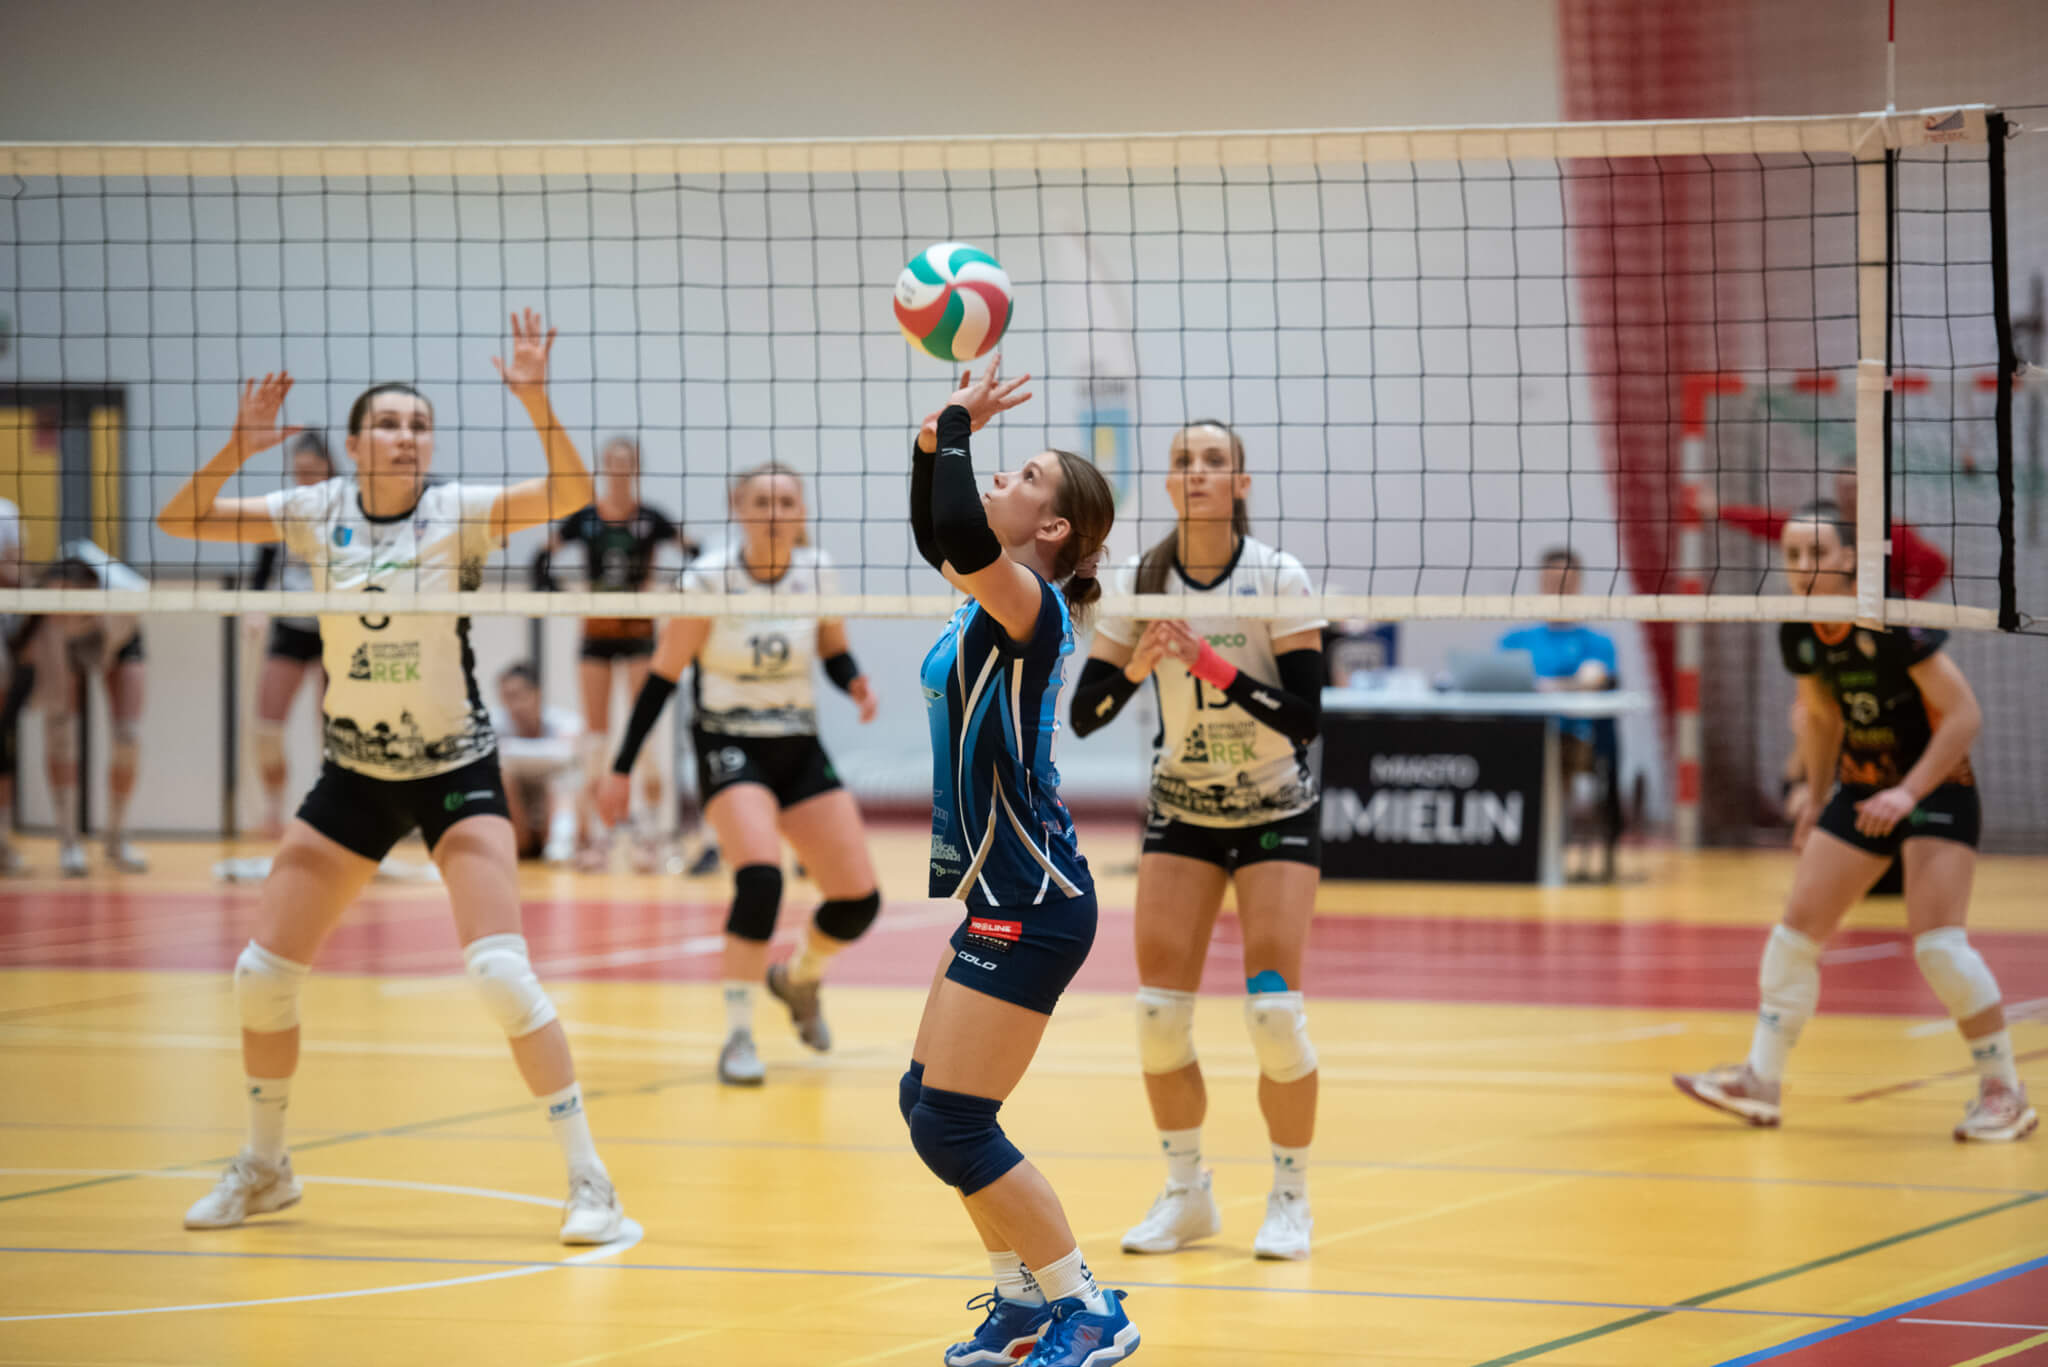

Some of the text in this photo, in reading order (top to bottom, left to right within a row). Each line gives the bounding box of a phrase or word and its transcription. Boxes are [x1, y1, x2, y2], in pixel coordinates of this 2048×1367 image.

[747, 634, 789, 668] 19
[373, 662, 421, 682] REK
[706, 746, 747, 783] 19
[1211, 742, 1257, 765] REK
[1321, 787, 1524, 846] IMIELIN
[958, 950, 998, 971] COLO
